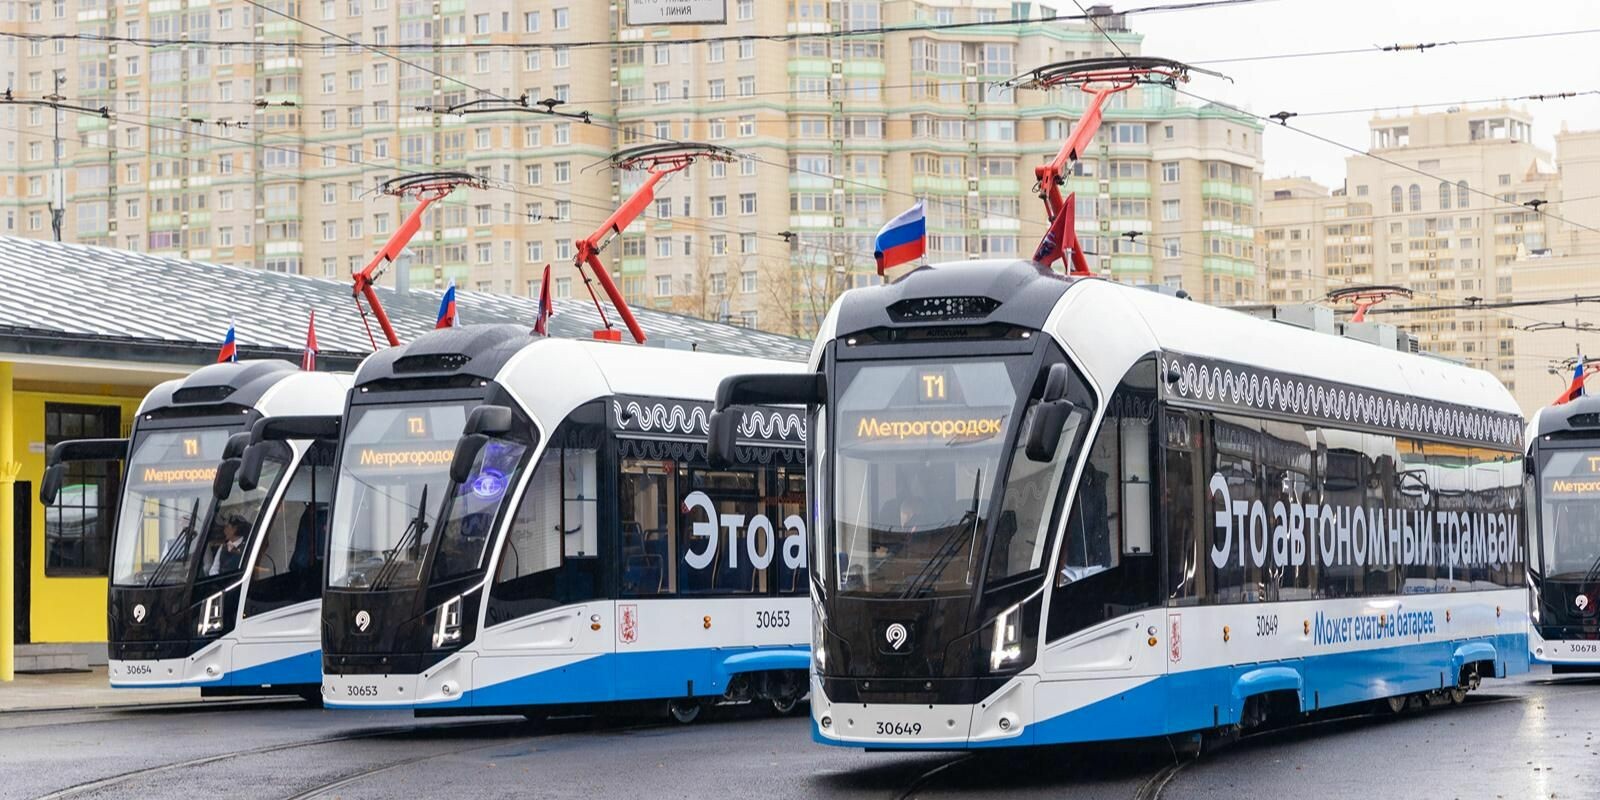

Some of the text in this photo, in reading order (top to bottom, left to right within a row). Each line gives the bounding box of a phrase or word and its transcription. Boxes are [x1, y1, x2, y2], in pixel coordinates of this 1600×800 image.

[666, 6, 692, 16] ЛИНИЯ
[923, 375, 945, 398] Т1
[407, 417, 425, 433] Т1
[858, 417, 1001, 439] Метрогородок
[1588, 456, 1600, 472] Т
[144, 468, 217, 485] Метрогородо
[684, 490, 807, 570] Это а
[1209, 472, 1524, 583] Это автономный трамвай.
[756, 610, 790, 628] 30653
[1256, 615, 1278, 637] 30649
[1313, 604, 1436, 646] Может ехать на батарее.
[1570, 644, 1597, 652] 30678
[127, 665, 152, 674] 30654
[347, 685, 378, 696] 30653
[876, 721, 922, 735] 30649
